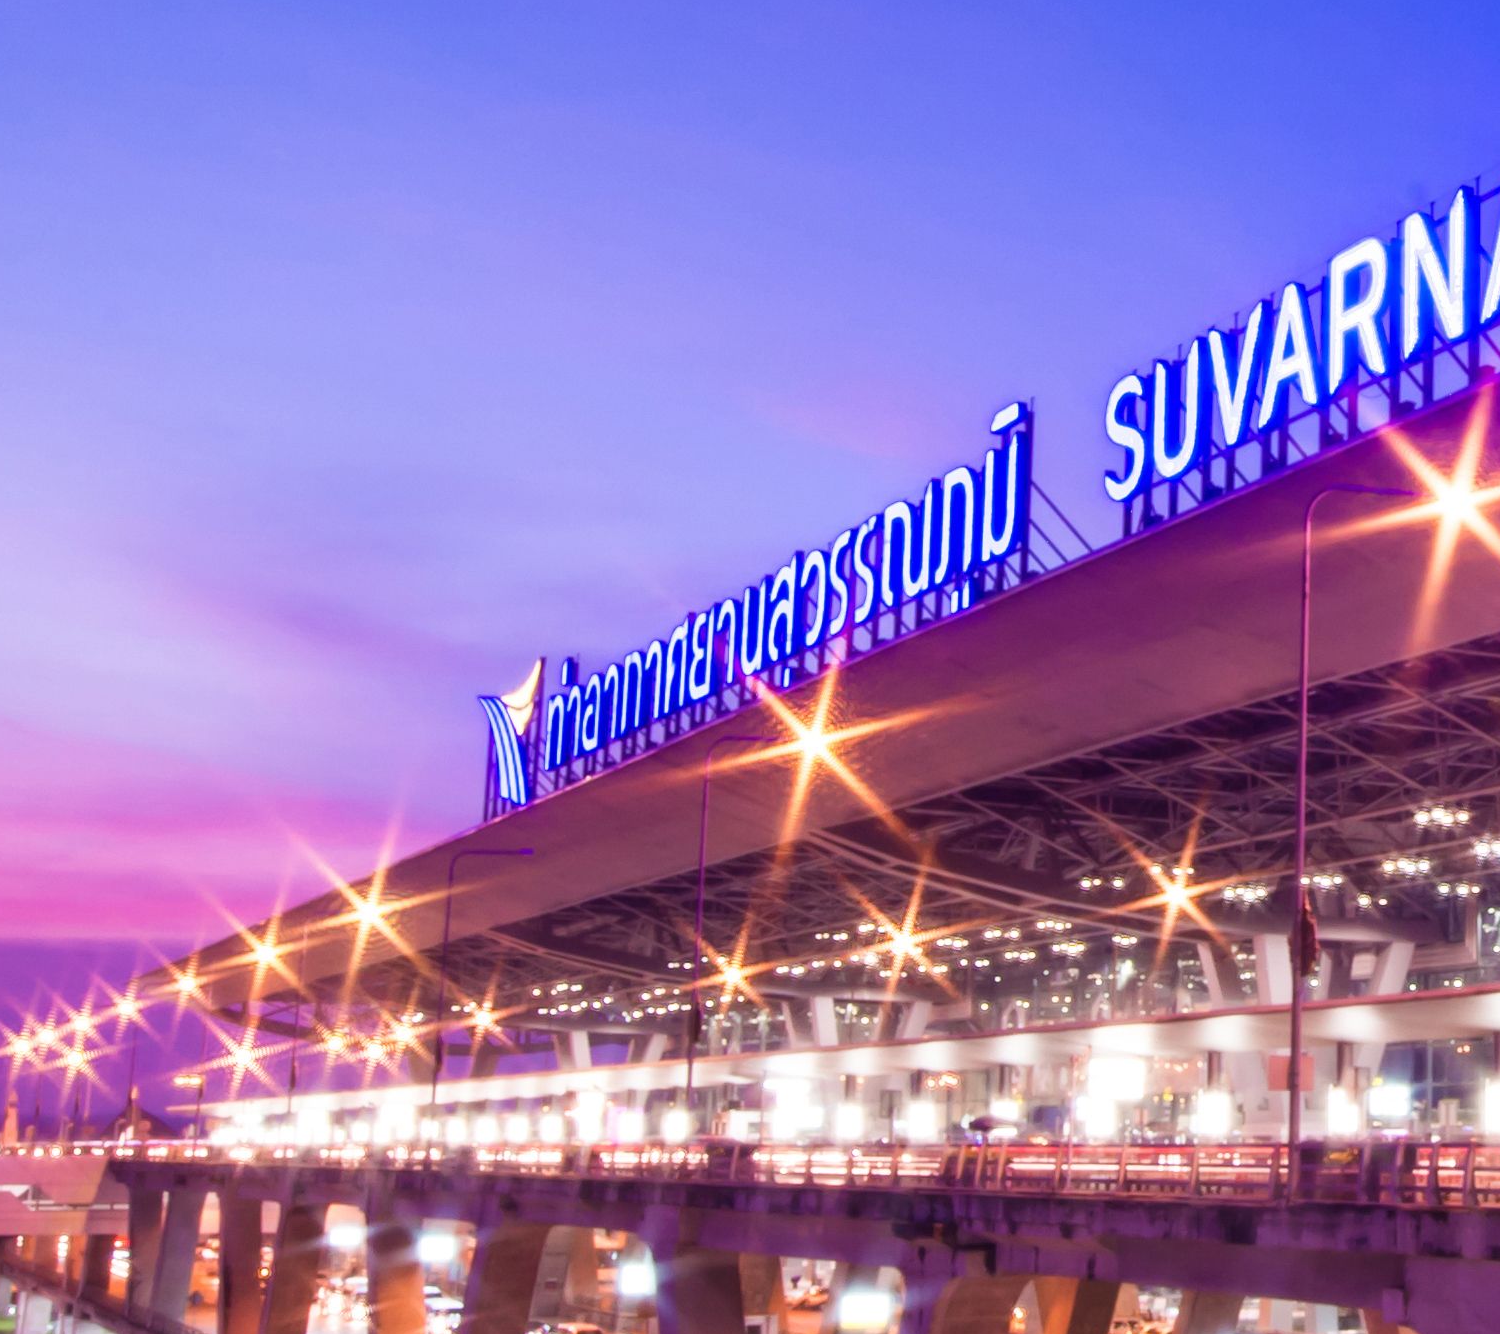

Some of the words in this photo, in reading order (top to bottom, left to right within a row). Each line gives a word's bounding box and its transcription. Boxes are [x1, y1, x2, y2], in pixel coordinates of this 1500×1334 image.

[544, 401, 1020, 772] ท่าอากาศยานสุวรรณภูมิ
